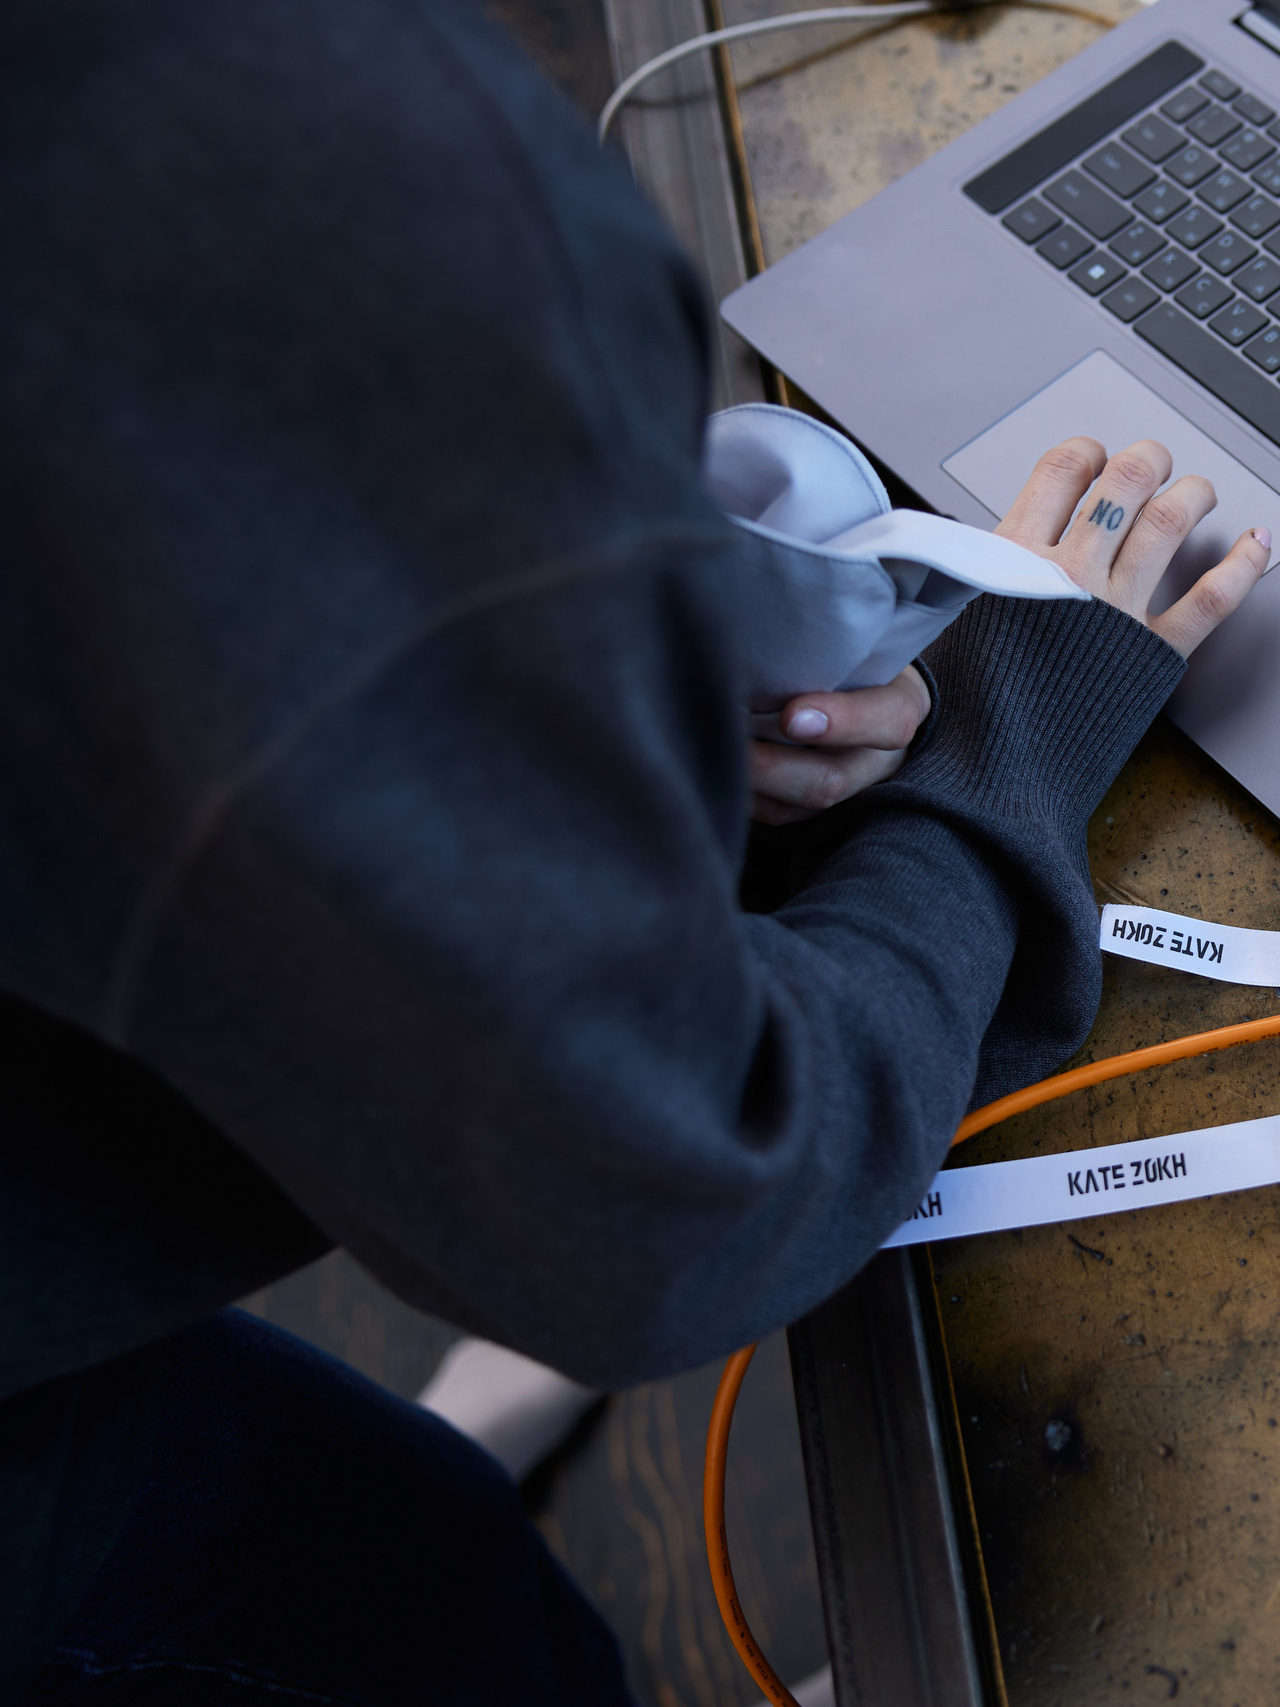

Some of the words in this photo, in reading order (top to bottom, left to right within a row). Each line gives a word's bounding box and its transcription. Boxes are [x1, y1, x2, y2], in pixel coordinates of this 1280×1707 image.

[1088, 497, 1124, 531] NO
[1112, 918, 1167, 948] ZOKH
[1169, 931, 1224, 964] KATE
[1067, 1163, 1126, 1197] KATE
[1129, 1152, 1187, 1186] ZOKH
